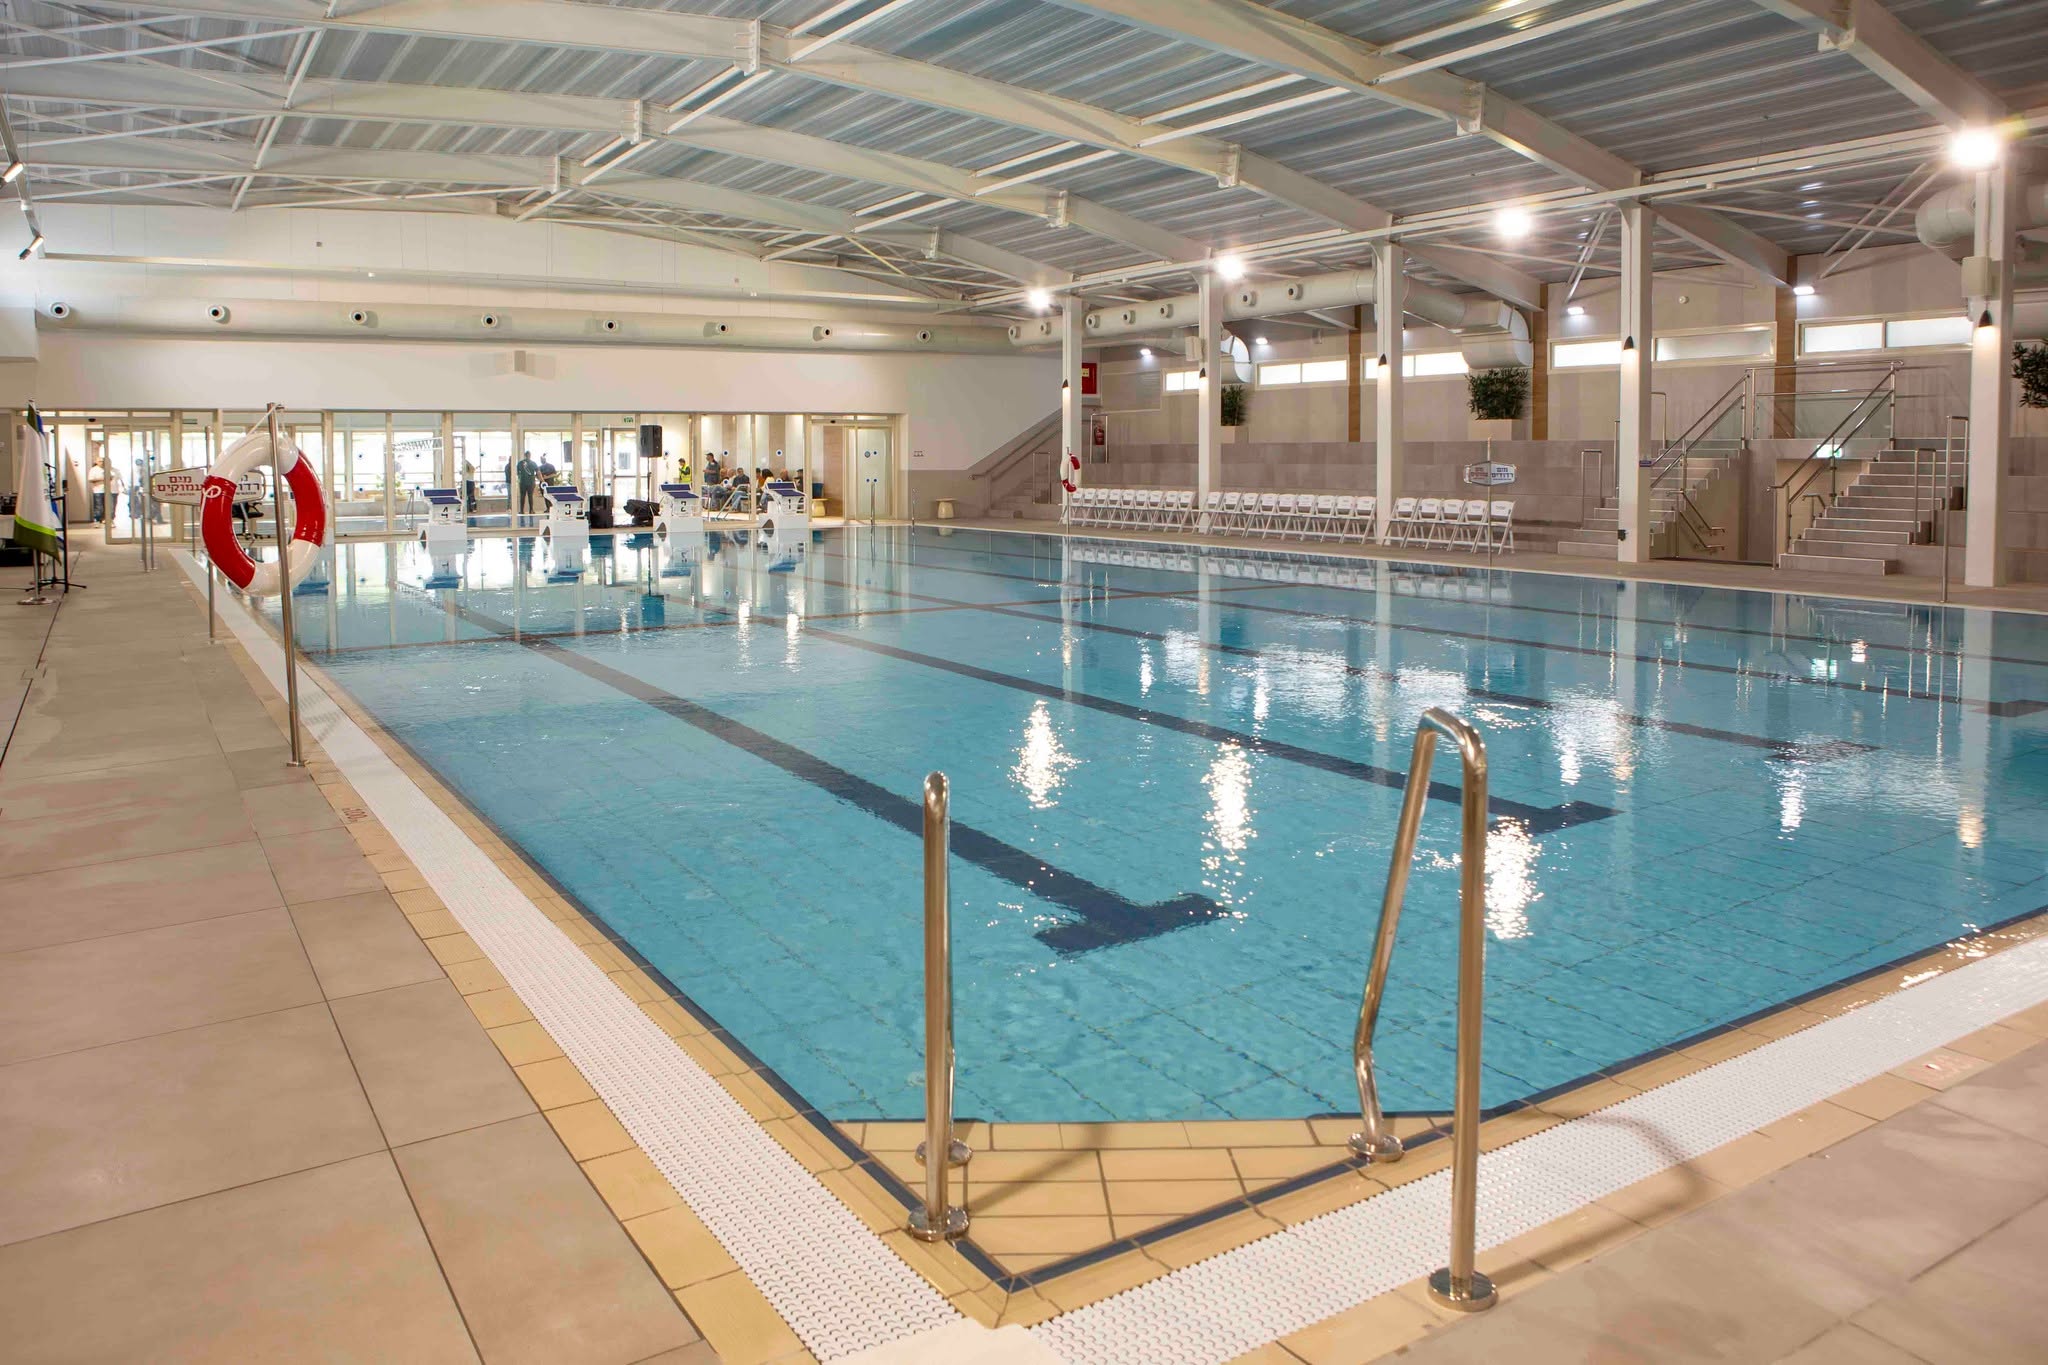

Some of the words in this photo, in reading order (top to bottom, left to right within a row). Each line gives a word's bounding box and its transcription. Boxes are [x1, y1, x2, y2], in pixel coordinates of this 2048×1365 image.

[168, 475, 192, 483] מים
[157, 483, 205, 493] עמוקים
[564, 503, 571, 515] 3
[680, 500, 687, 512] 2
[441, 506, 449, 519] 4
